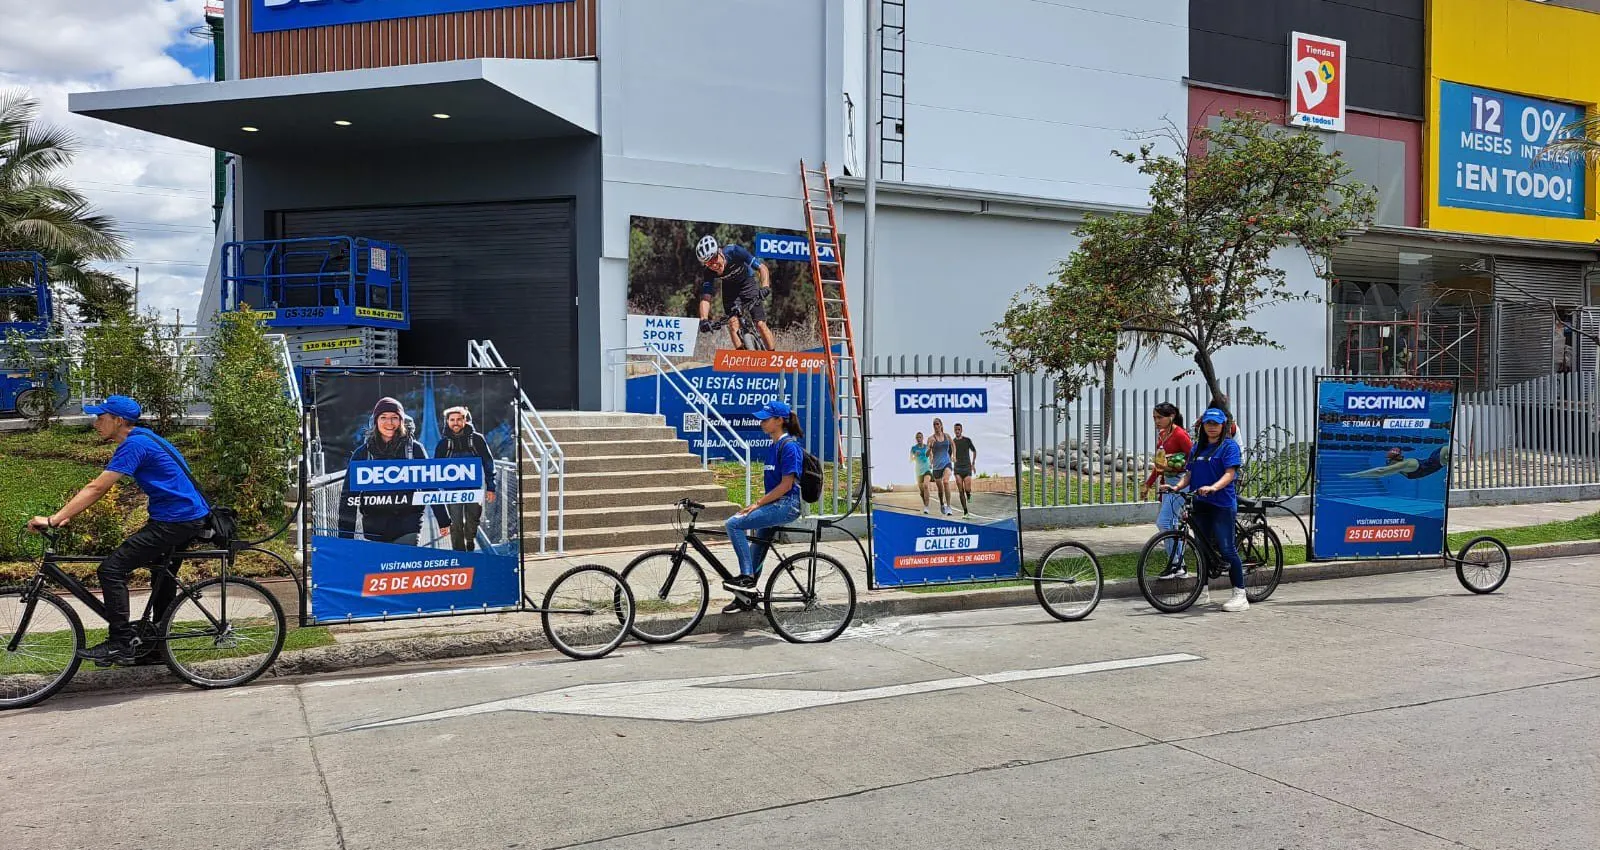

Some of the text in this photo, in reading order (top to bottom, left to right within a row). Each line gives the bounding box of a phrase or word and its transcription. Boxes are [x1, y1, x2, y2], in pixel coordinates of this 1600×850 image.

[1305, 45, 1335, 58] Tiendas
[1312, 116, 1334, 126] todos!
[1472, 96, 1501, 133] 12
[1521, 106, 1571, 145] 0%
[1461, 131, 1512, 156] MESES
[1456, 161, 1573, 204] ¡EN TODO!
[760, 238, 835, 258] DECATHON
[284, 307, 325, 319] GS-3246
[645, 318, 681, 329] MAKE
[643, 330, 683, 341] SPORT
[643, 342, 685, 353] YOURS
[721, 353, 835, 369] Apertura 25 de agos
[691, 376, 703, 389] SI
[706, 374, 744, 390] ESTÁS
[686, 392, 791, 407] PARA EL DEPORE
[899, 393, 983, 409] DECATHLON
[1347, 395, 1426, 410] DECATHLON
[733, 418, 741, 427] tu
[1342, 420, 1424, 428] SE TOMA LA CALLE 80
[356, 463, 476, 485] DECATHLON
[347, 491, 475, 507] SE TOMA LA CALLE 80
[926, 526, 968, 536] SE TOMA LA
[1349, 528, 1411, 539] 25 DE AGOSTO
[924, 537, 971, 550] CALLE 80
[380, 558, 460, 571] VISÍTANOS DESDE EL
[930, 556, 948, 564] DESDE
[949, 555, 956, 563] EL
[957, 555, 964, 563] 25
[965, 554, 972, 562] DE
[973, 553, 996, 562] AGOSTO
[369, 573, 467, 592] 25 DE AGOSTO
